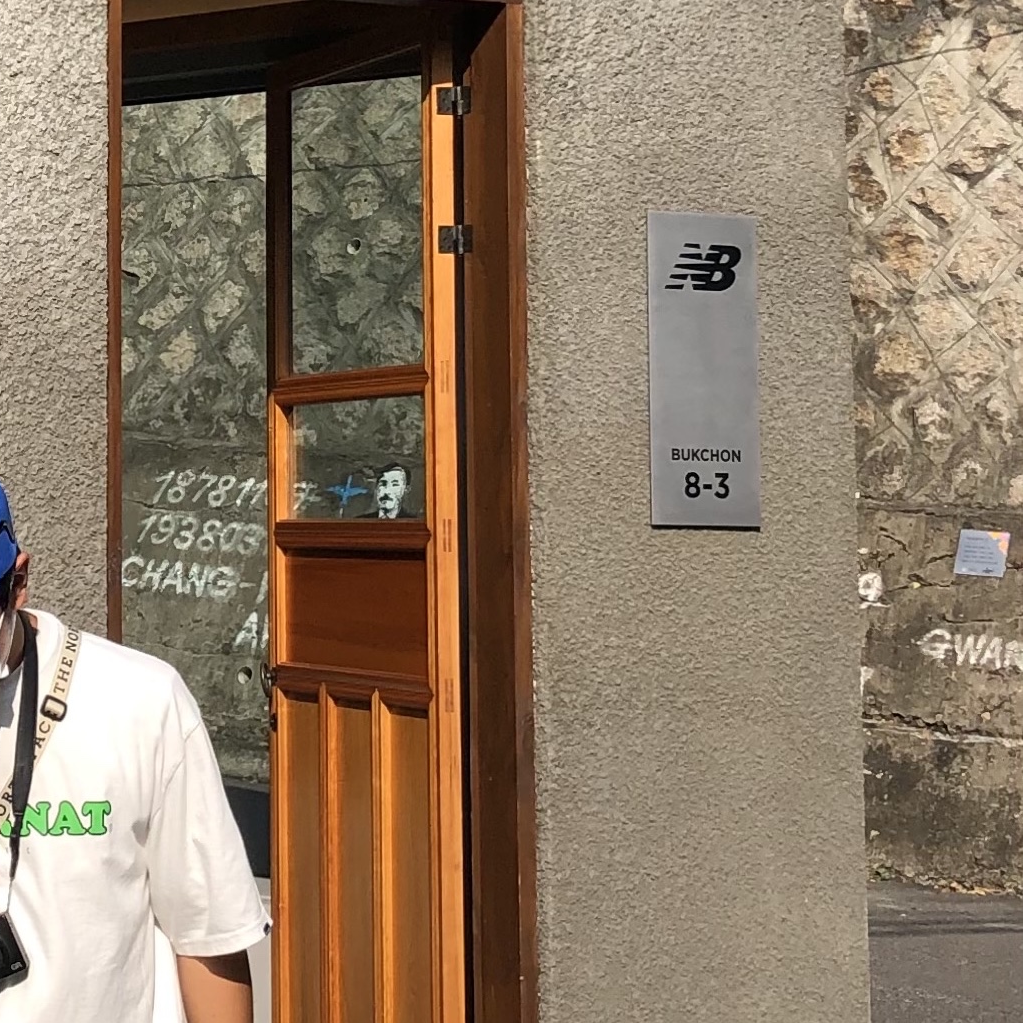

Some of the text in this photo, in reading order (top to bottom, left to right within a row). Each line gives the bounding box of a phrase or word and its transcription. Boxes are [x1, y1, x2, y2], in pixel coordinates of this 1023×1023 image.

[671, 448, 741, 462] BUKCHON
[684, 472, 729, 499] 8-3
[137, 513, 267, 555] 193803
[53, 656, 73, 693] THE
